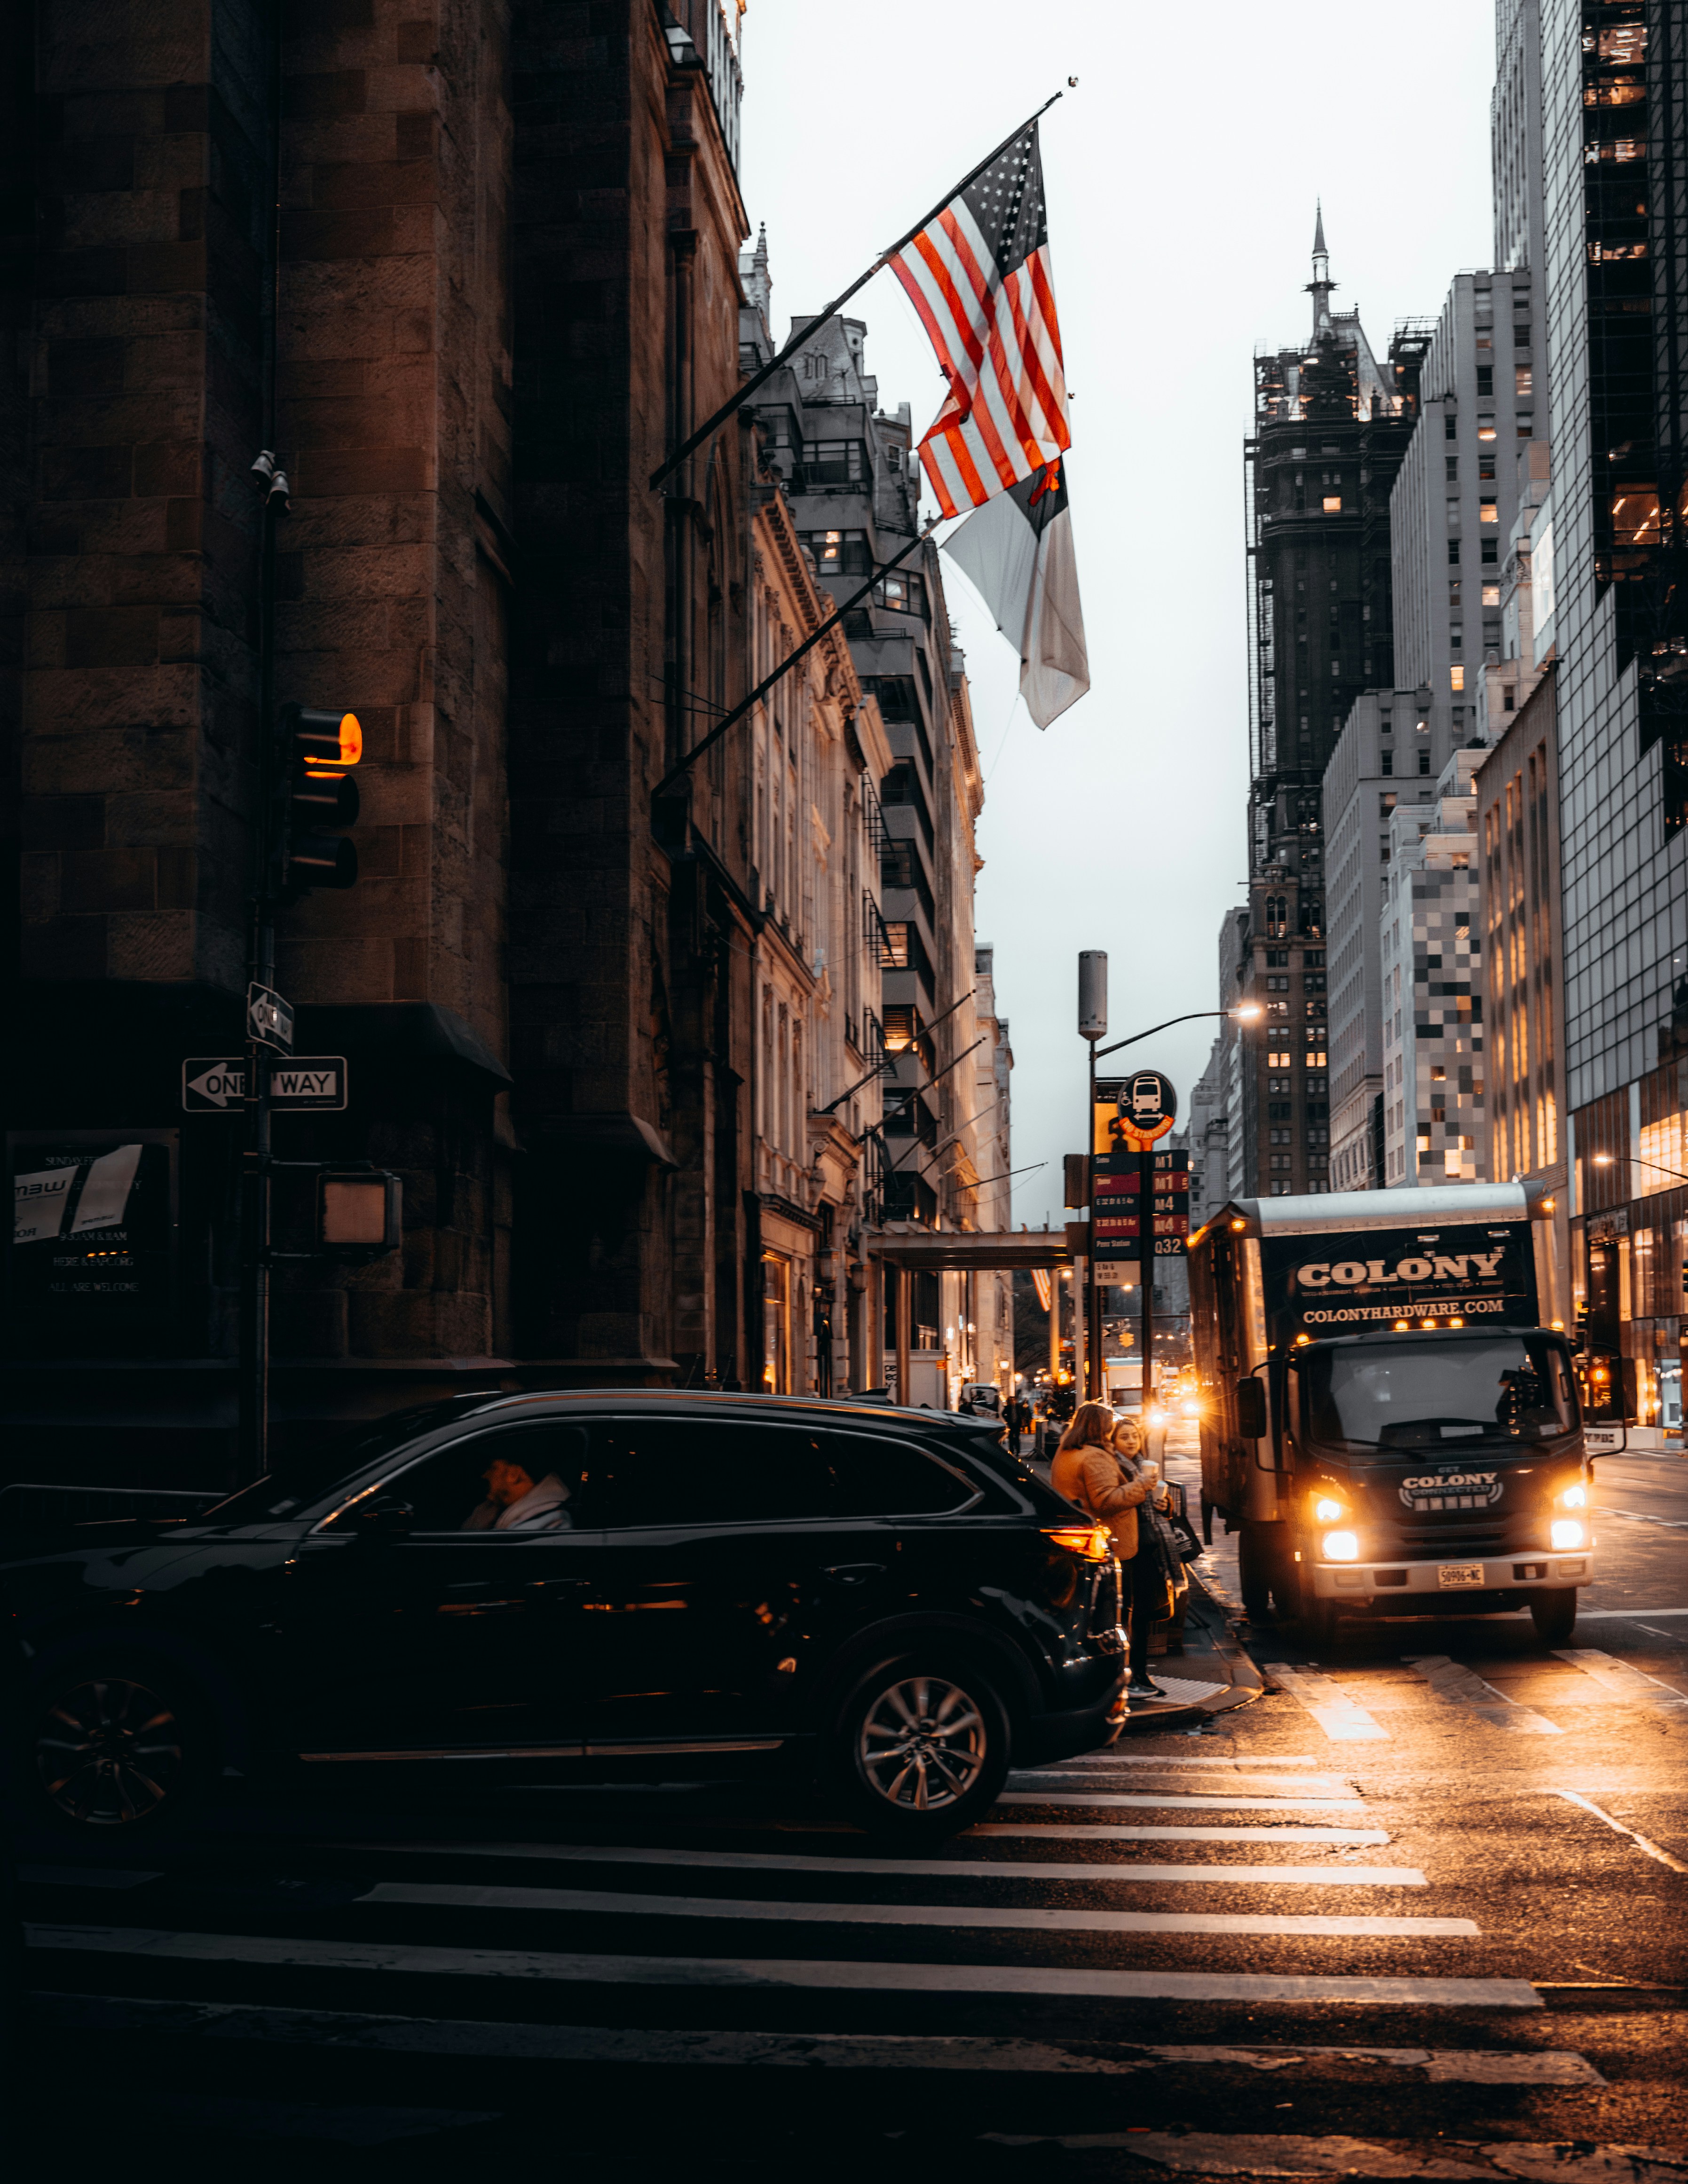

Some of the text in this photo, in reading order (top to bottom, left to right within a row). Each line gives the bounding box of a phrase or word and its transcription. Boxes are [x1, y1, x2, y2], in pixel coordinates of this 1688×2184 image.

[206, 1073, 330, 1095] ONE WAY
[1155, 1153, 1173, 1168] M1
[1155, 1174, 1173, 1190] M1
[1154, 1195, 1174, 1211] M4
[1154, 1217, 1174, 1232] M4
[1155, 1238, 1182, 1254] Q32
[1297, 1252, 1504, 1287] COLONY
[47, 1282, 140, 1292] ALL ARE WELCOME
[1302, 1299, 1505, 1324] COLONYHARDWARE.COM
[1402, 1472, 1498, 1490] COLONY
